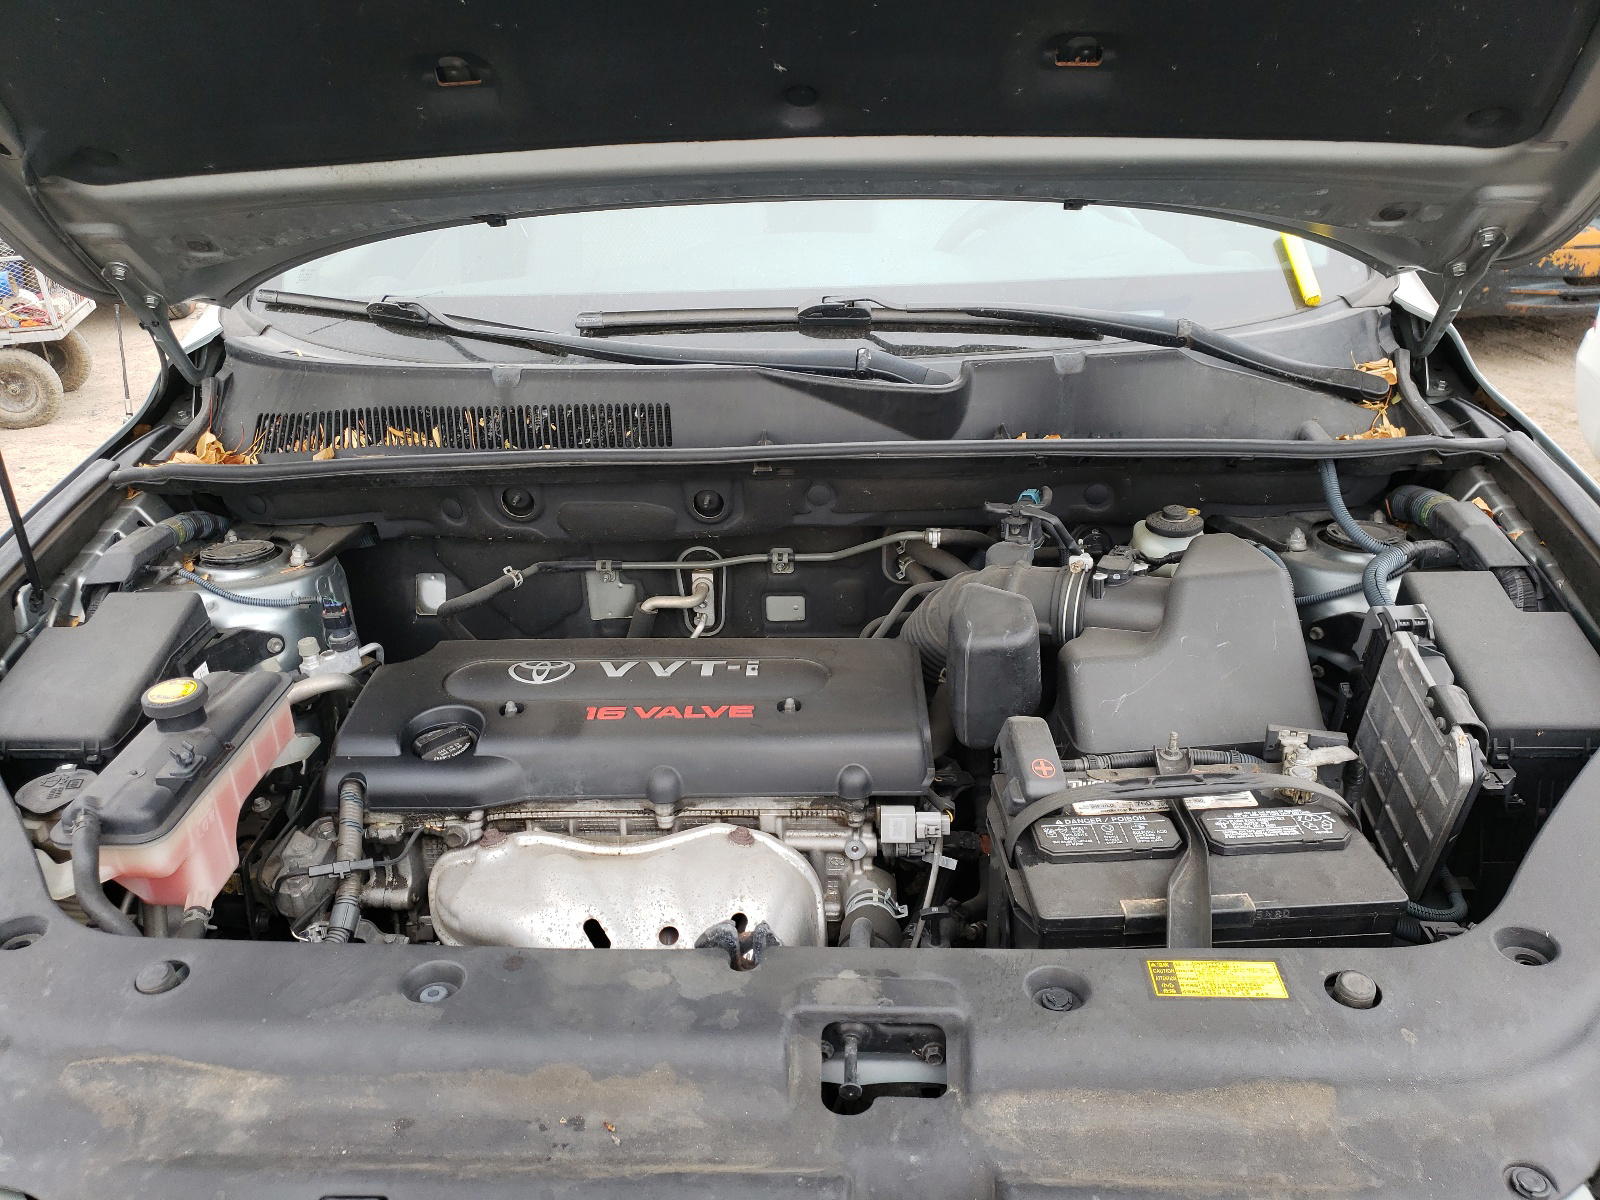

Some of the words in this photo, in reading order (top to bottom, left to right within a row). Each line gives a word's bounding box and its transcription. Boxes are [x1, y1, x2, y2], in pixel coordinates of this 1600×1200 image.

[600, 660, 760, 677] VVT-i
[586, 706, 628, 720] 16
[633, 705, 756, 719] VALVE
